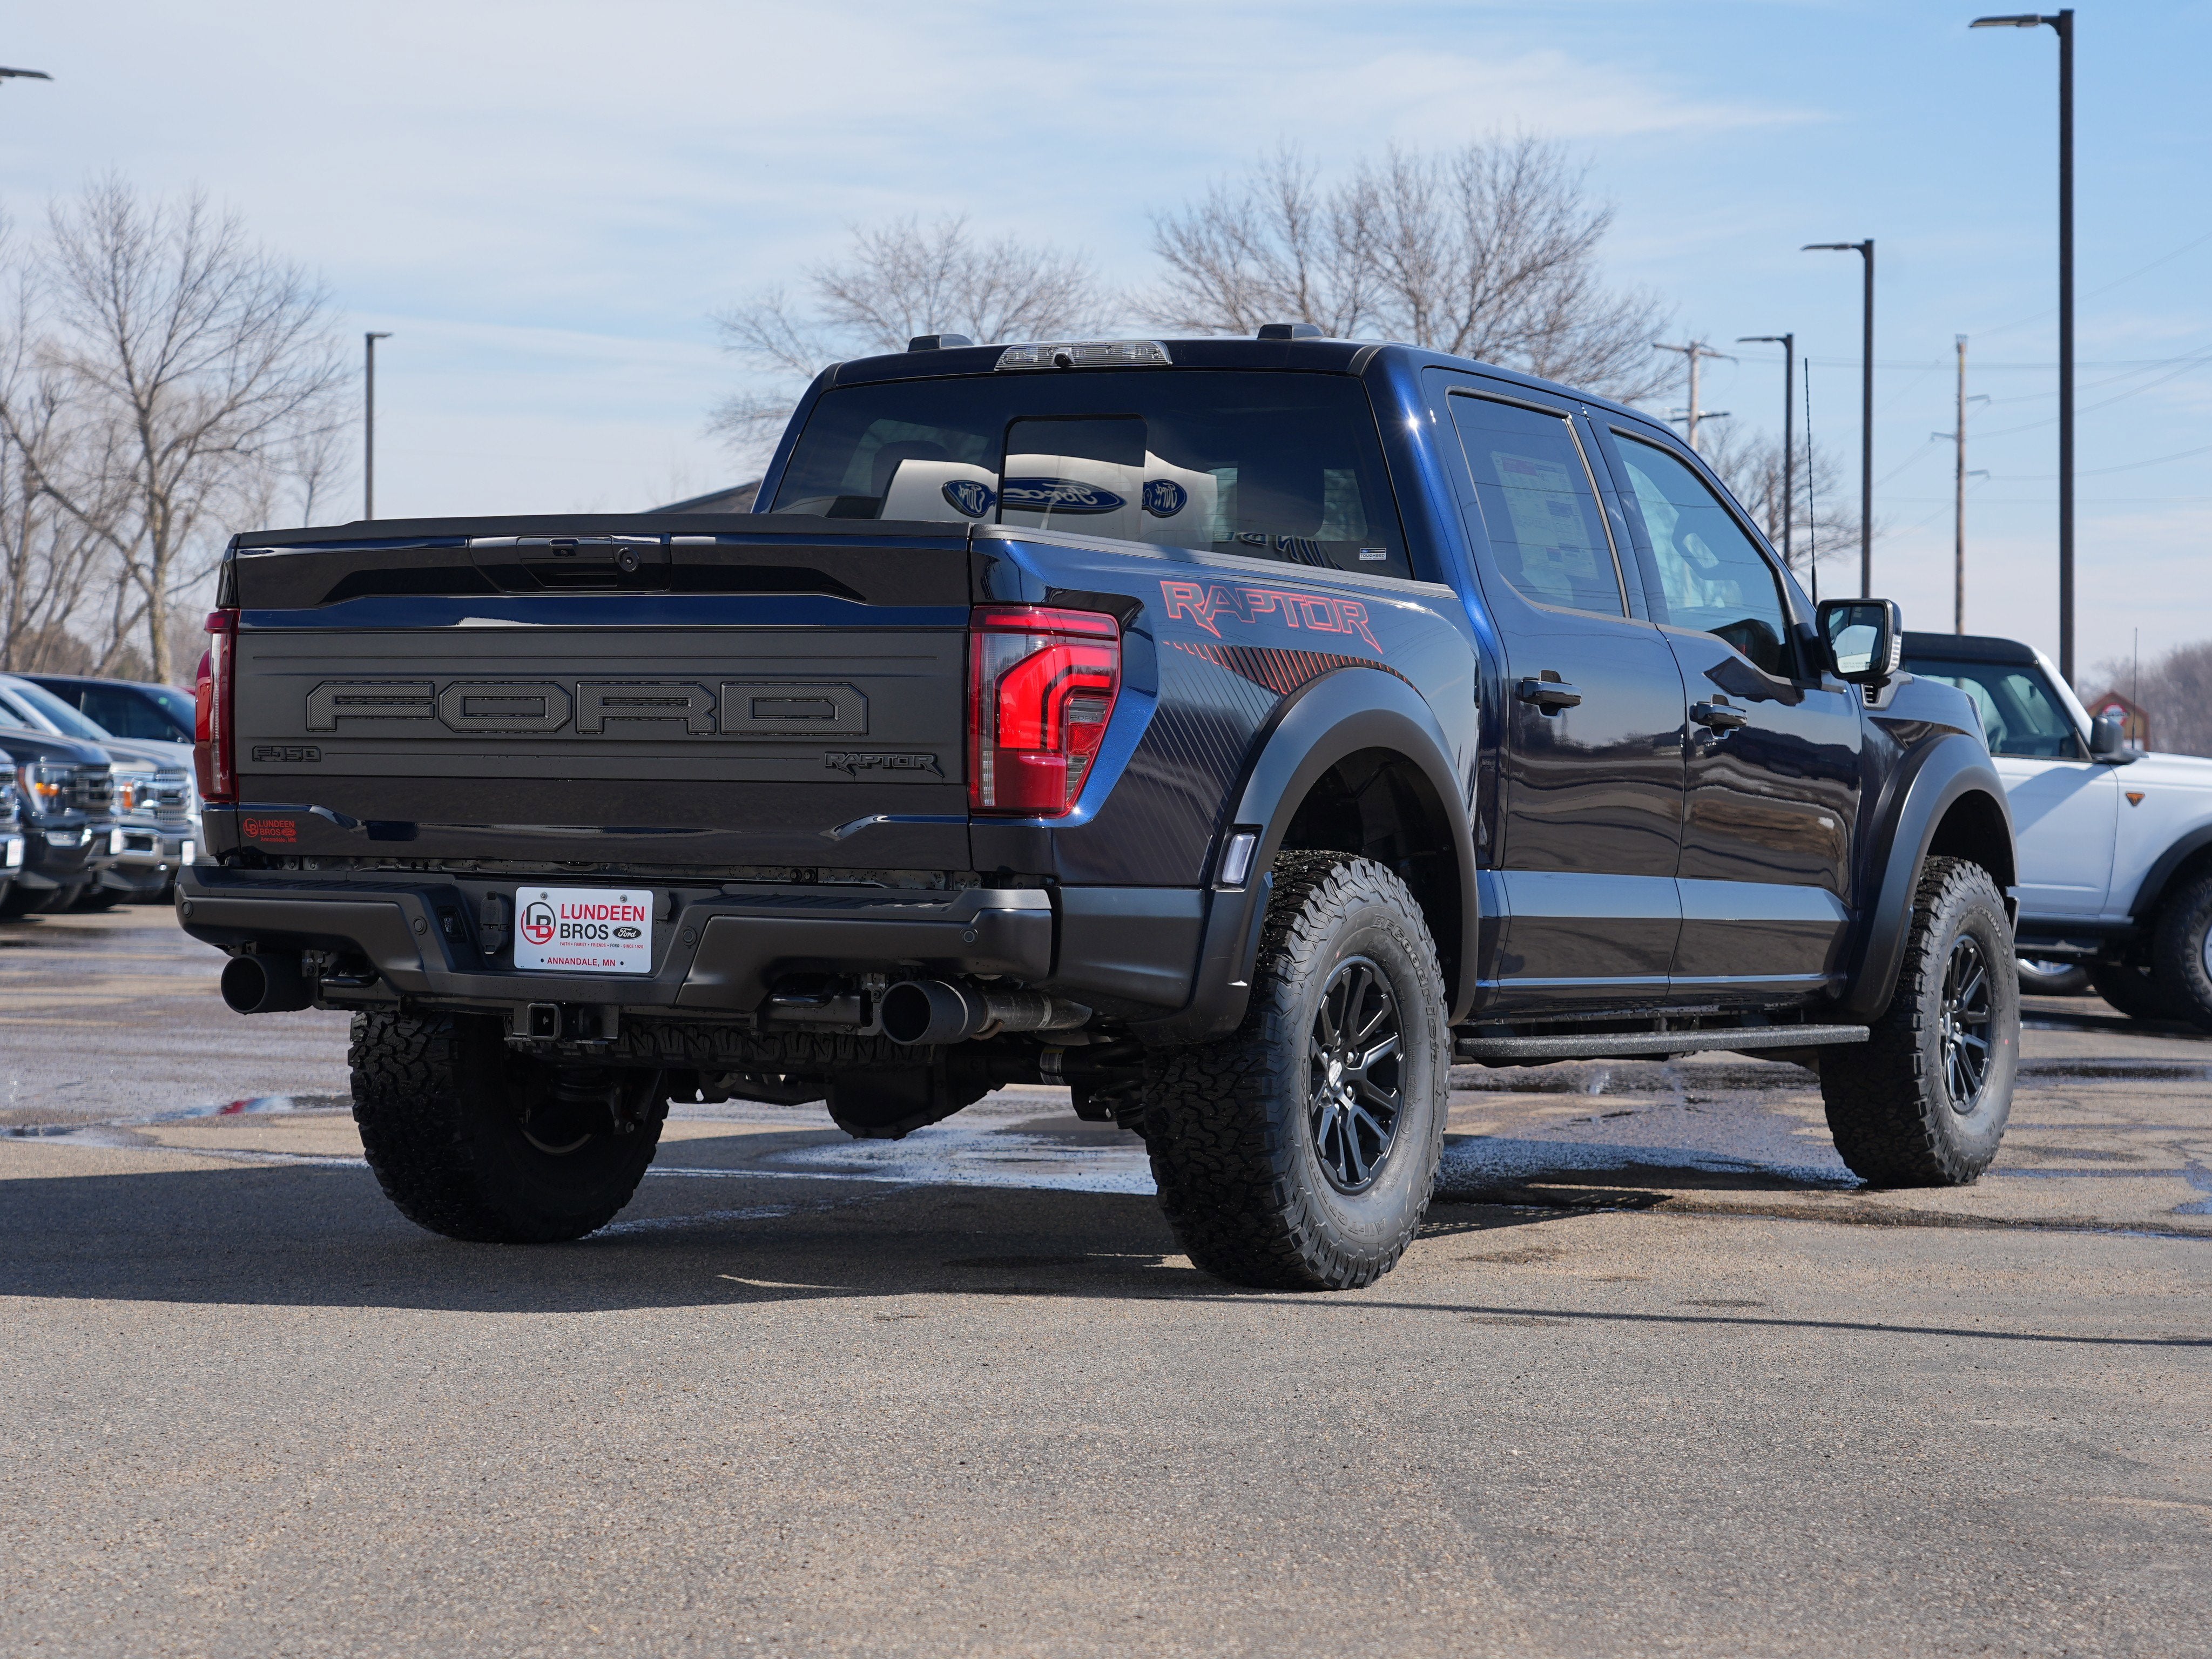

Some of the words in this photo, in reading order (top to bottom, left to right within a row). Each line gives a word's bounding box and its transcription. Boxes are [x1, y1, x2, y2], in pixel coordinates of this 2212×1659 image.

[1159, 581, 1382, 654] RAPTOR
[306, 680, 868, 736] FORD
[825, 751, 946, 778] RAPTOR
[259, 820, 295, 828] LUNDEEN
[260, 828, 281, 836] BROS
[561, 903, 645, 921] LUNDEEN
[560, 923, 609, 940] BROS
[618, 927, 637, 938] Ford
[547, 957, 600, 967] ANNANDALE,
[1371, 914, 1439, 1064] BFGoodrich
